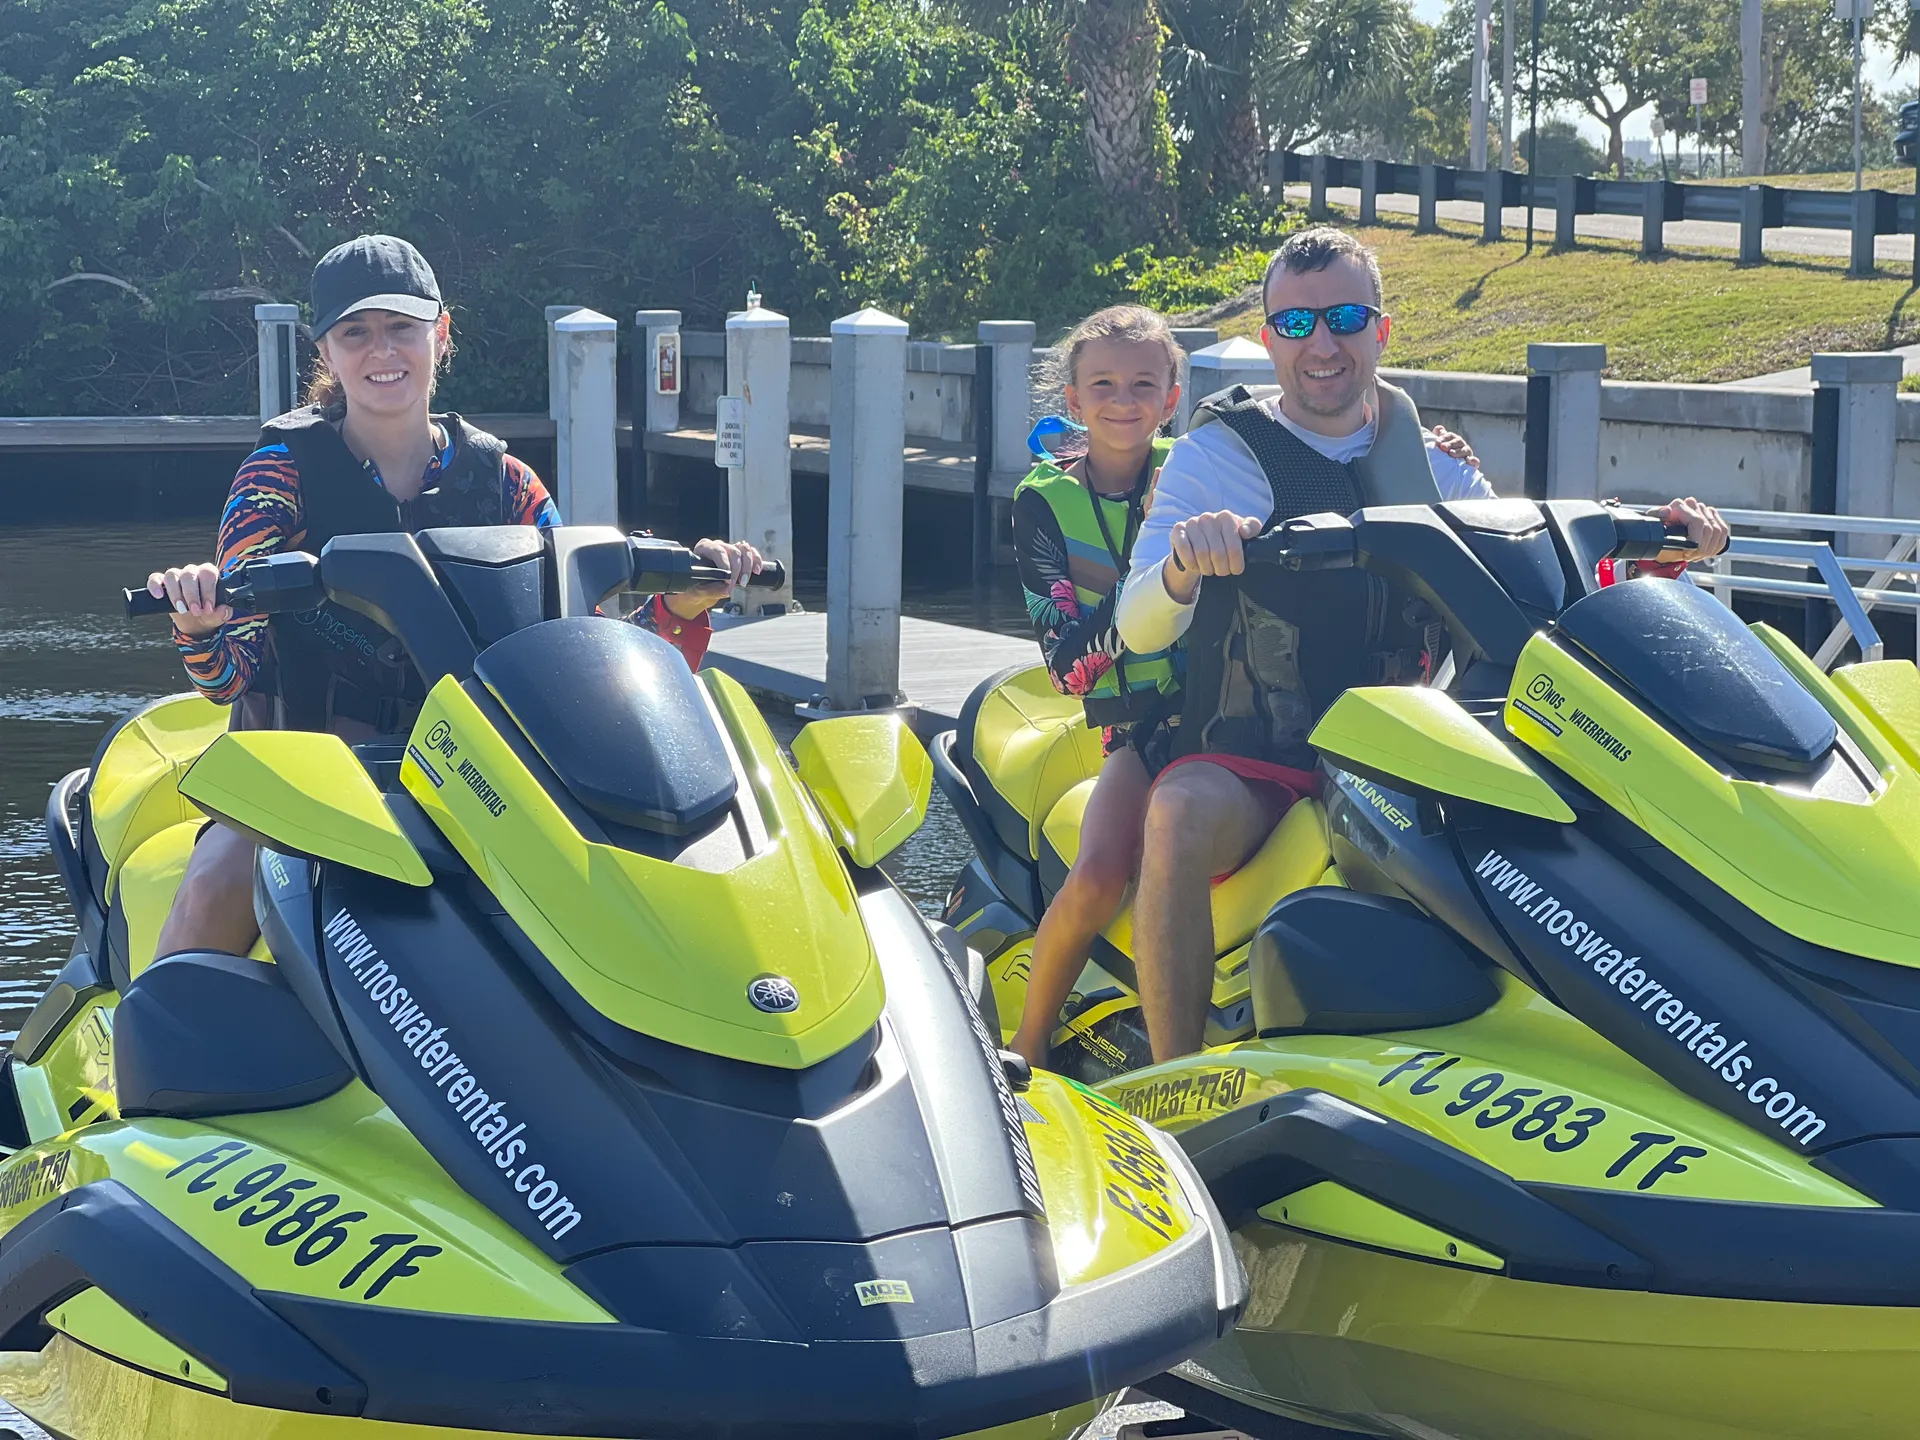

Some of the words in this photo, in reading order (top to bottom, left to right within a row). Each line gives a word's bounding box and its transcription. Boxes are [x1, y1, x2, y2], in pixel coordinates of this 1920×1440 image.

[321, 609, 375, 656] hyperlite
[1474, 849, 1827, 1146] www.noswaterrentals.com
[323, 907, 582, 1241] www.noswaterrentals.com
[1073, 1018, 1127, 1063] CRUISER
[1119, 1067, 1246, 1123] (561)287-7750
[1377, 1051, 1461, 1096] FL
[1444, 1072, 1606, 1153] 9583
[1605, 1131, 1707, 1191] TF
[1096, 1118, 1173, 1207] 9586
[165, 1141, 253, 1194] FL
[213, 1163, 368, 1267] 9586
[339, 1233, 443, 1300] TF
[1105, 1182, 1173, 1242] FL
[860, 1284, 907, 1298] NOS
